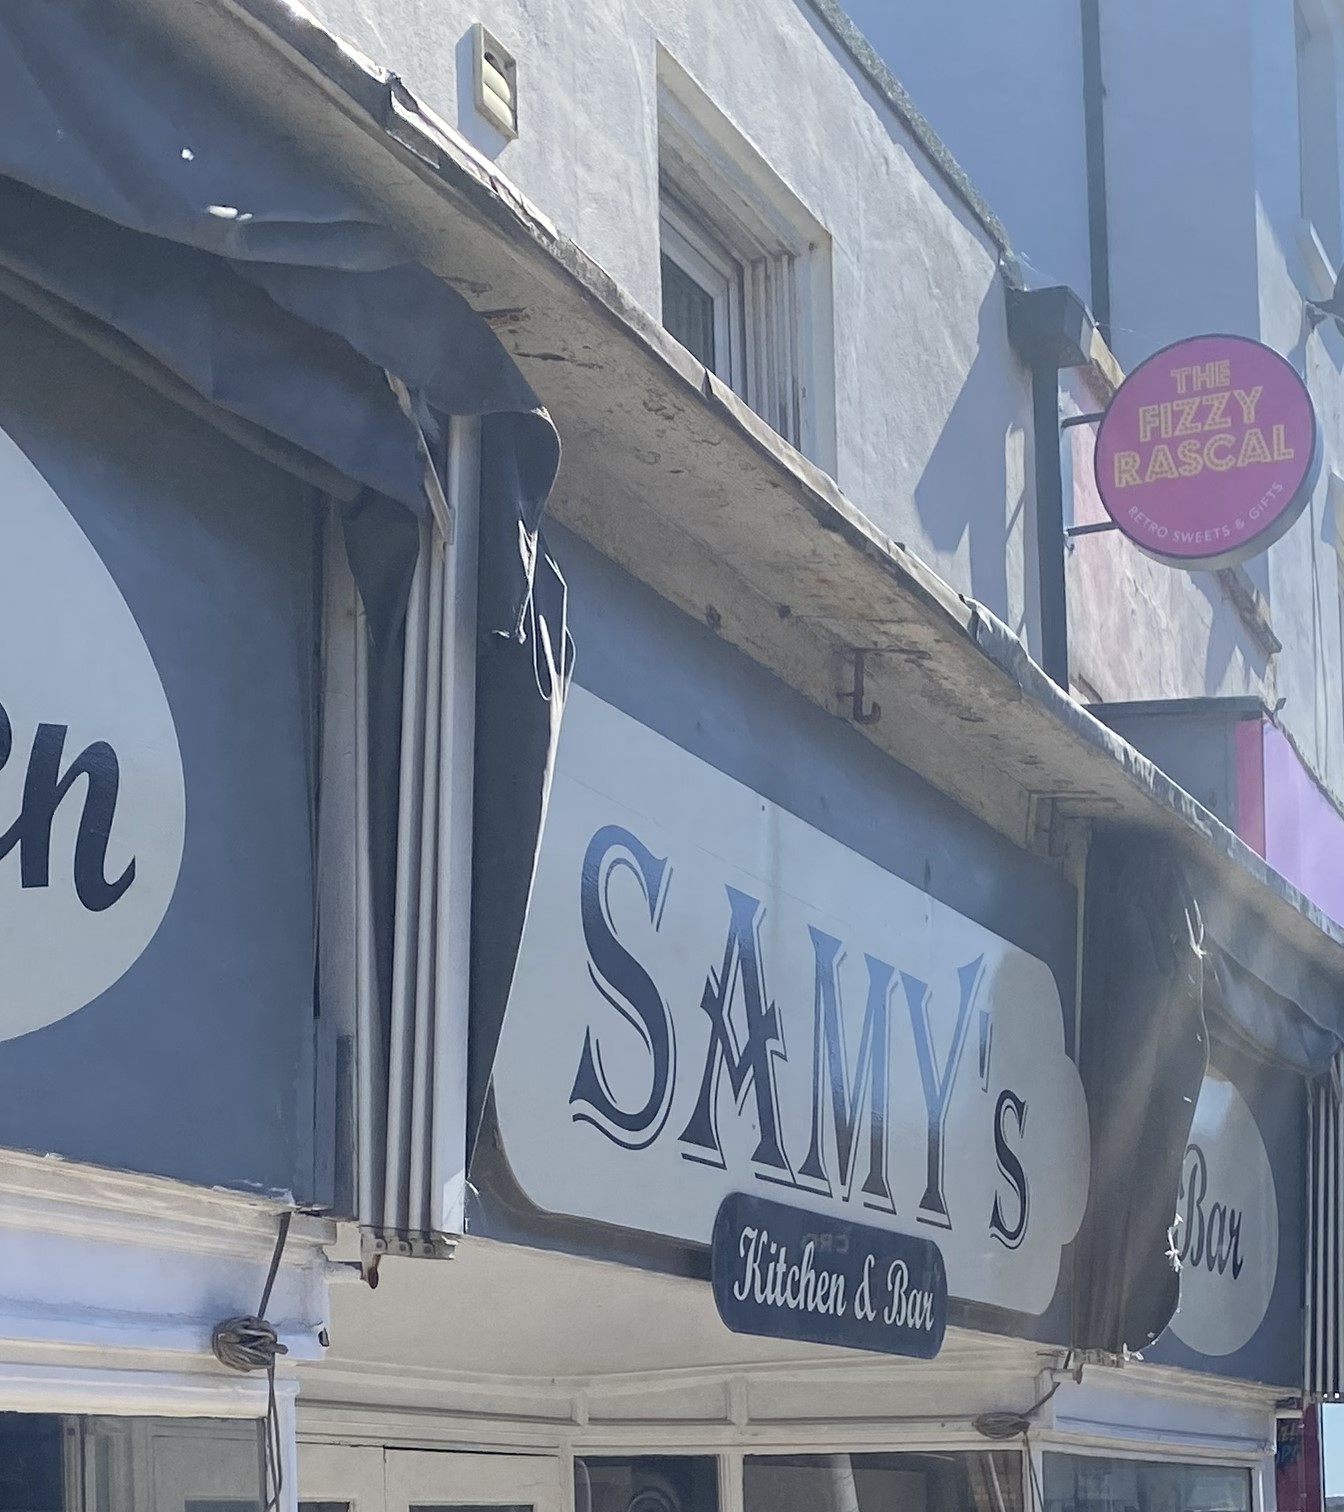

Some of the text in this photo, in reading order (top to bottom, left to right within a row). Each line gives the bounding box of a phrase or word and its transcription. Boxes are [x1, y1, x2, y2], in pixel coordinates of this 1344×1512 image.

[1170, 360, 1230, 394] THE
[1138, 385, 1264, 442] FIZZY
[1113, 424, 1295, 488] RASCAL
[1128, 481, 1283, 544] RETRO SWEETS & GIFTS
[1178, 1143, 1244, 1281] Bar
[733, 1226, 935, 1331] Kitchen & Bar
